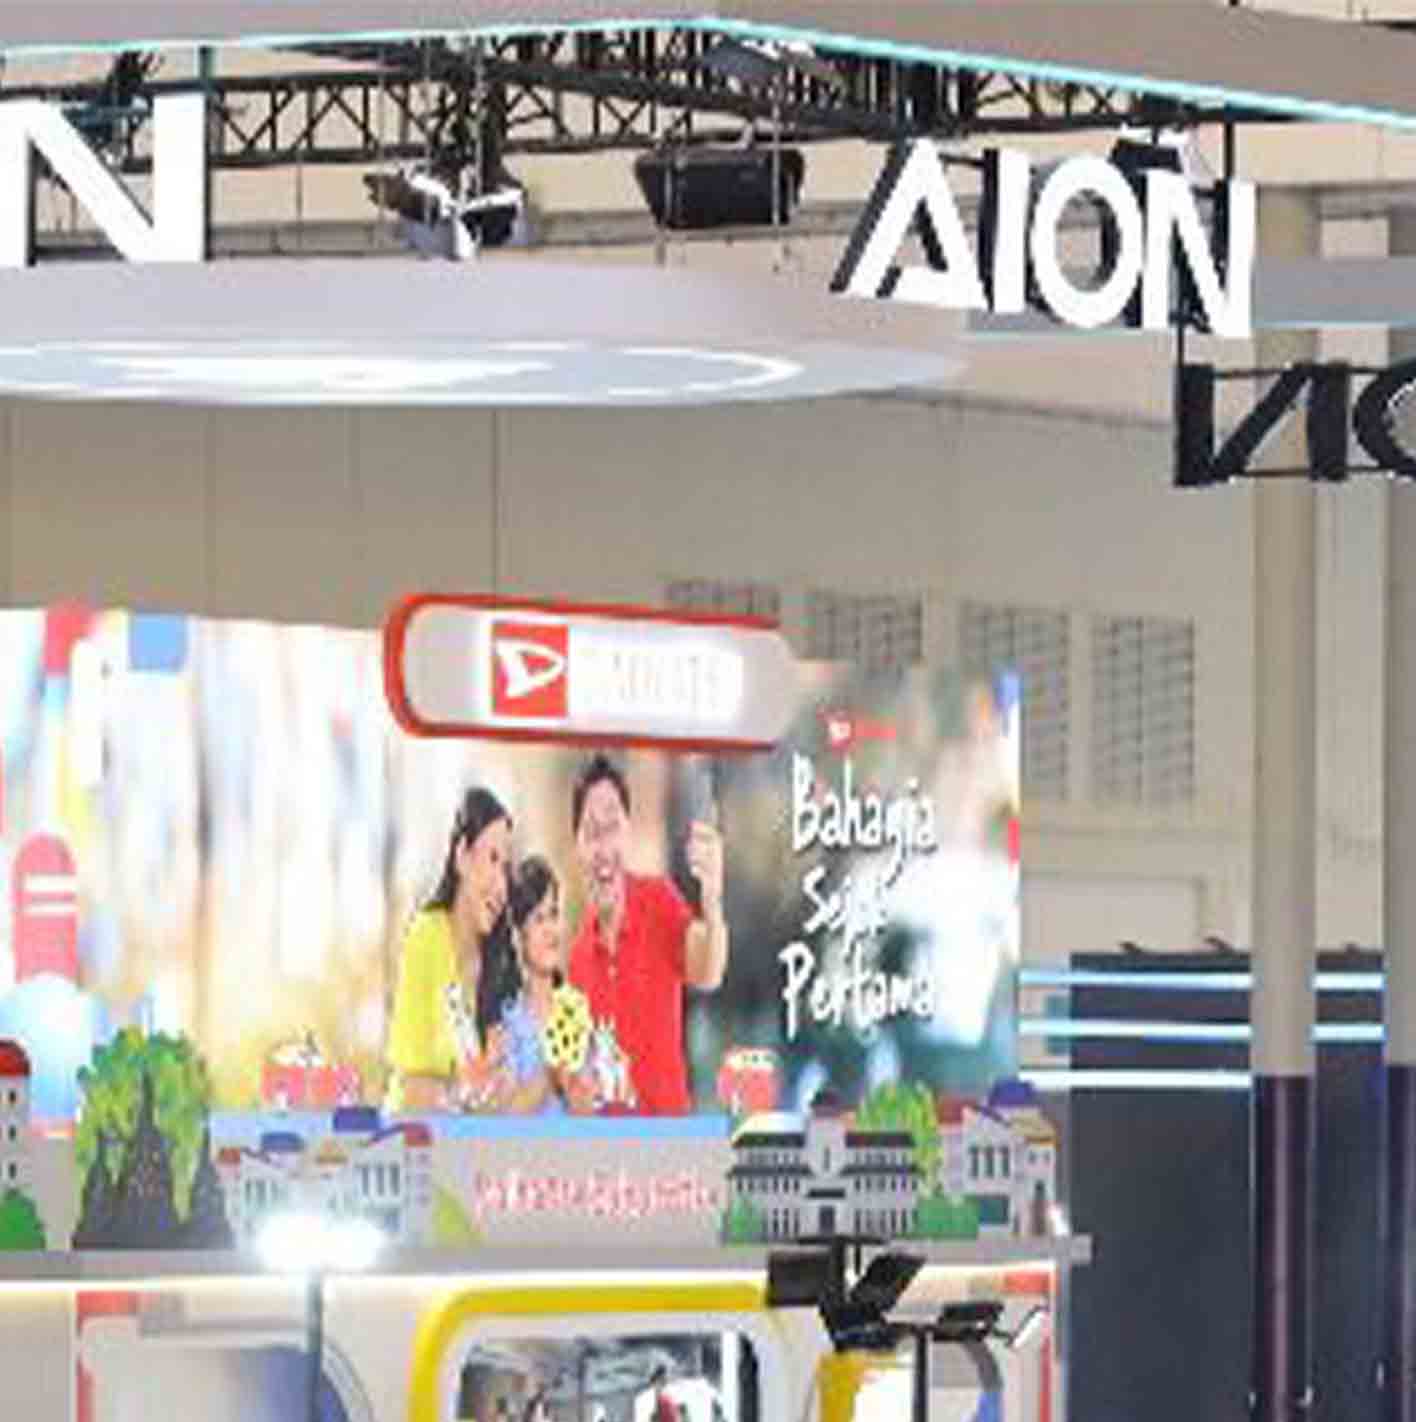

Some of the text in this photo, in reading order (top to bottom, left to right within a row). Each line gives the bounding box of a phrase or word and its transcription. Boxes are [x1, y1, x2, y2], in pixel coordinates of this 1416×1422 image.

[0, 94, 205, 266] N
[832, 137, 1256, 337] AION
[793, 752, 938, 888] Bahagia
[778, 941, 938, 1042] Pertama
